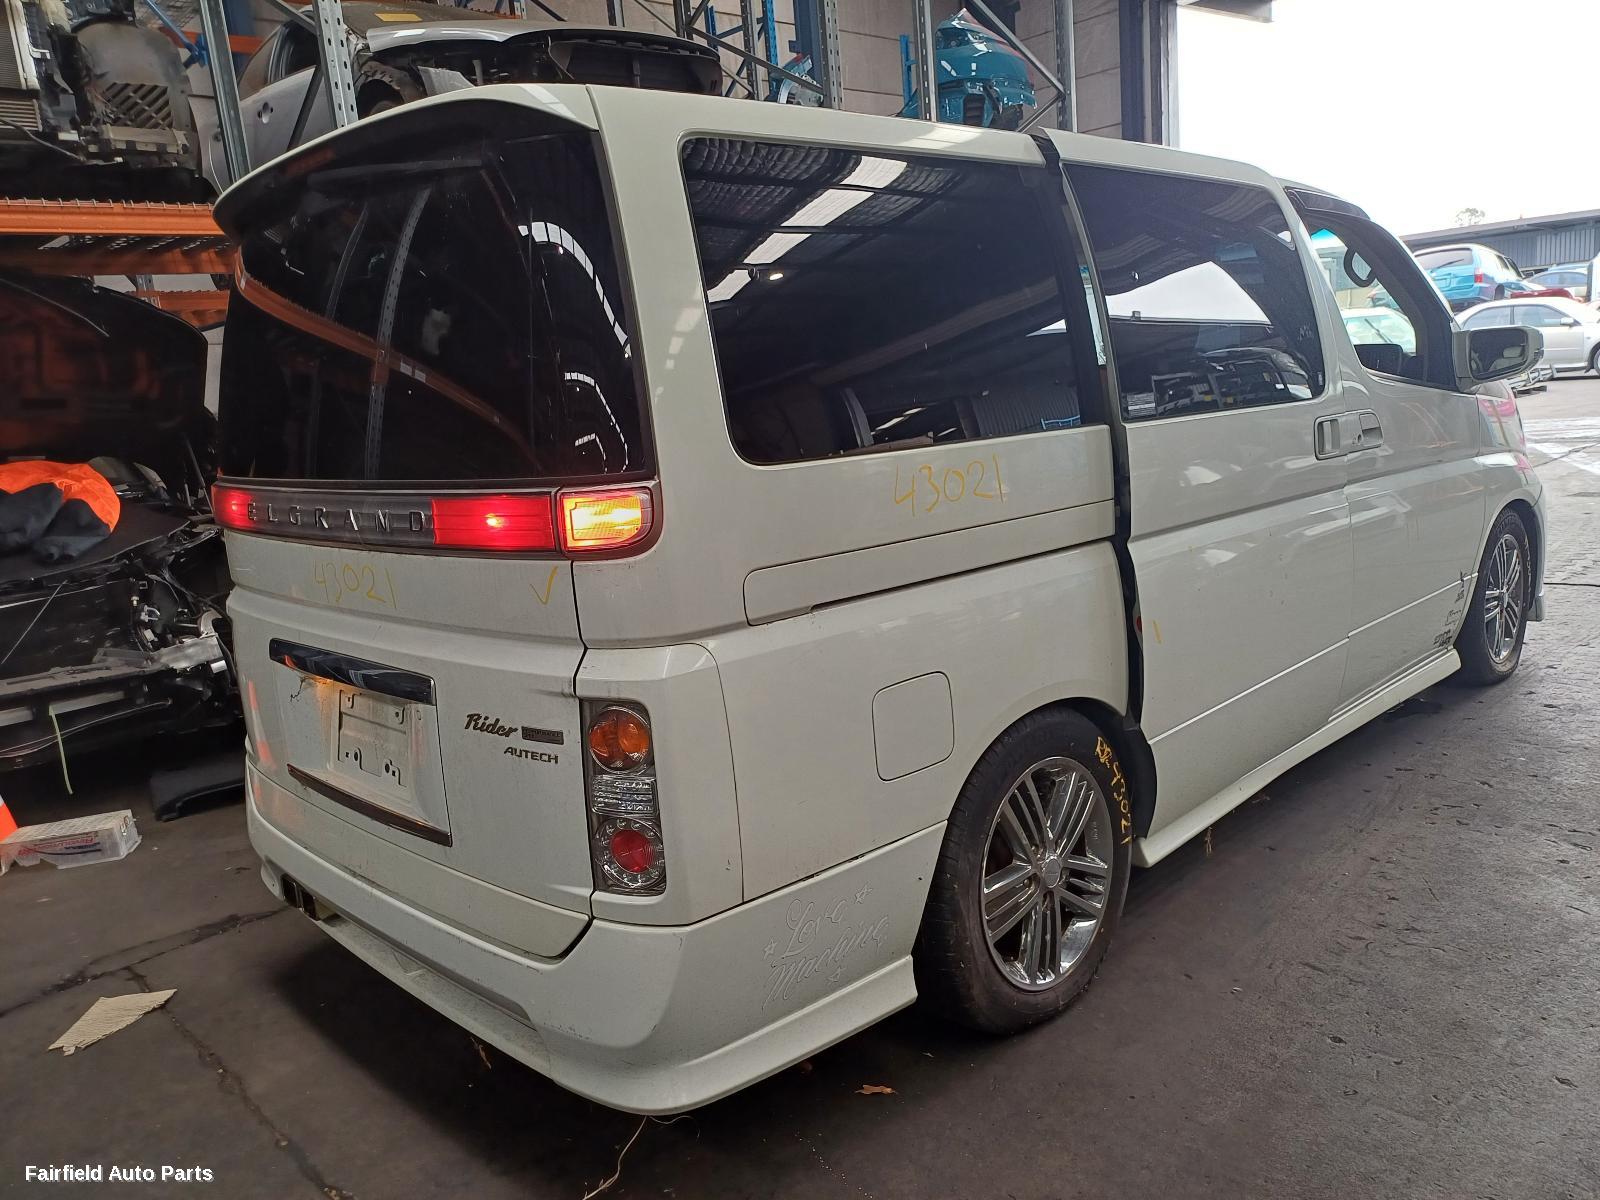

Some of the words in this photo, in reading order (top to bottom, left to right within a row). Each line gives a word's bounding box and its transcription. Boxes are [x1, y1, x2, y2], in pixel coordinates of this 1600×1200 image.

[894, 452, 1004, 517] 43021
[247, 502, 425, 532] ELGRAND
[314, 560, 397, 609] 43021
[464, 713, 519, 738] Rider
[503, 746, 559, 765] AUTECH
